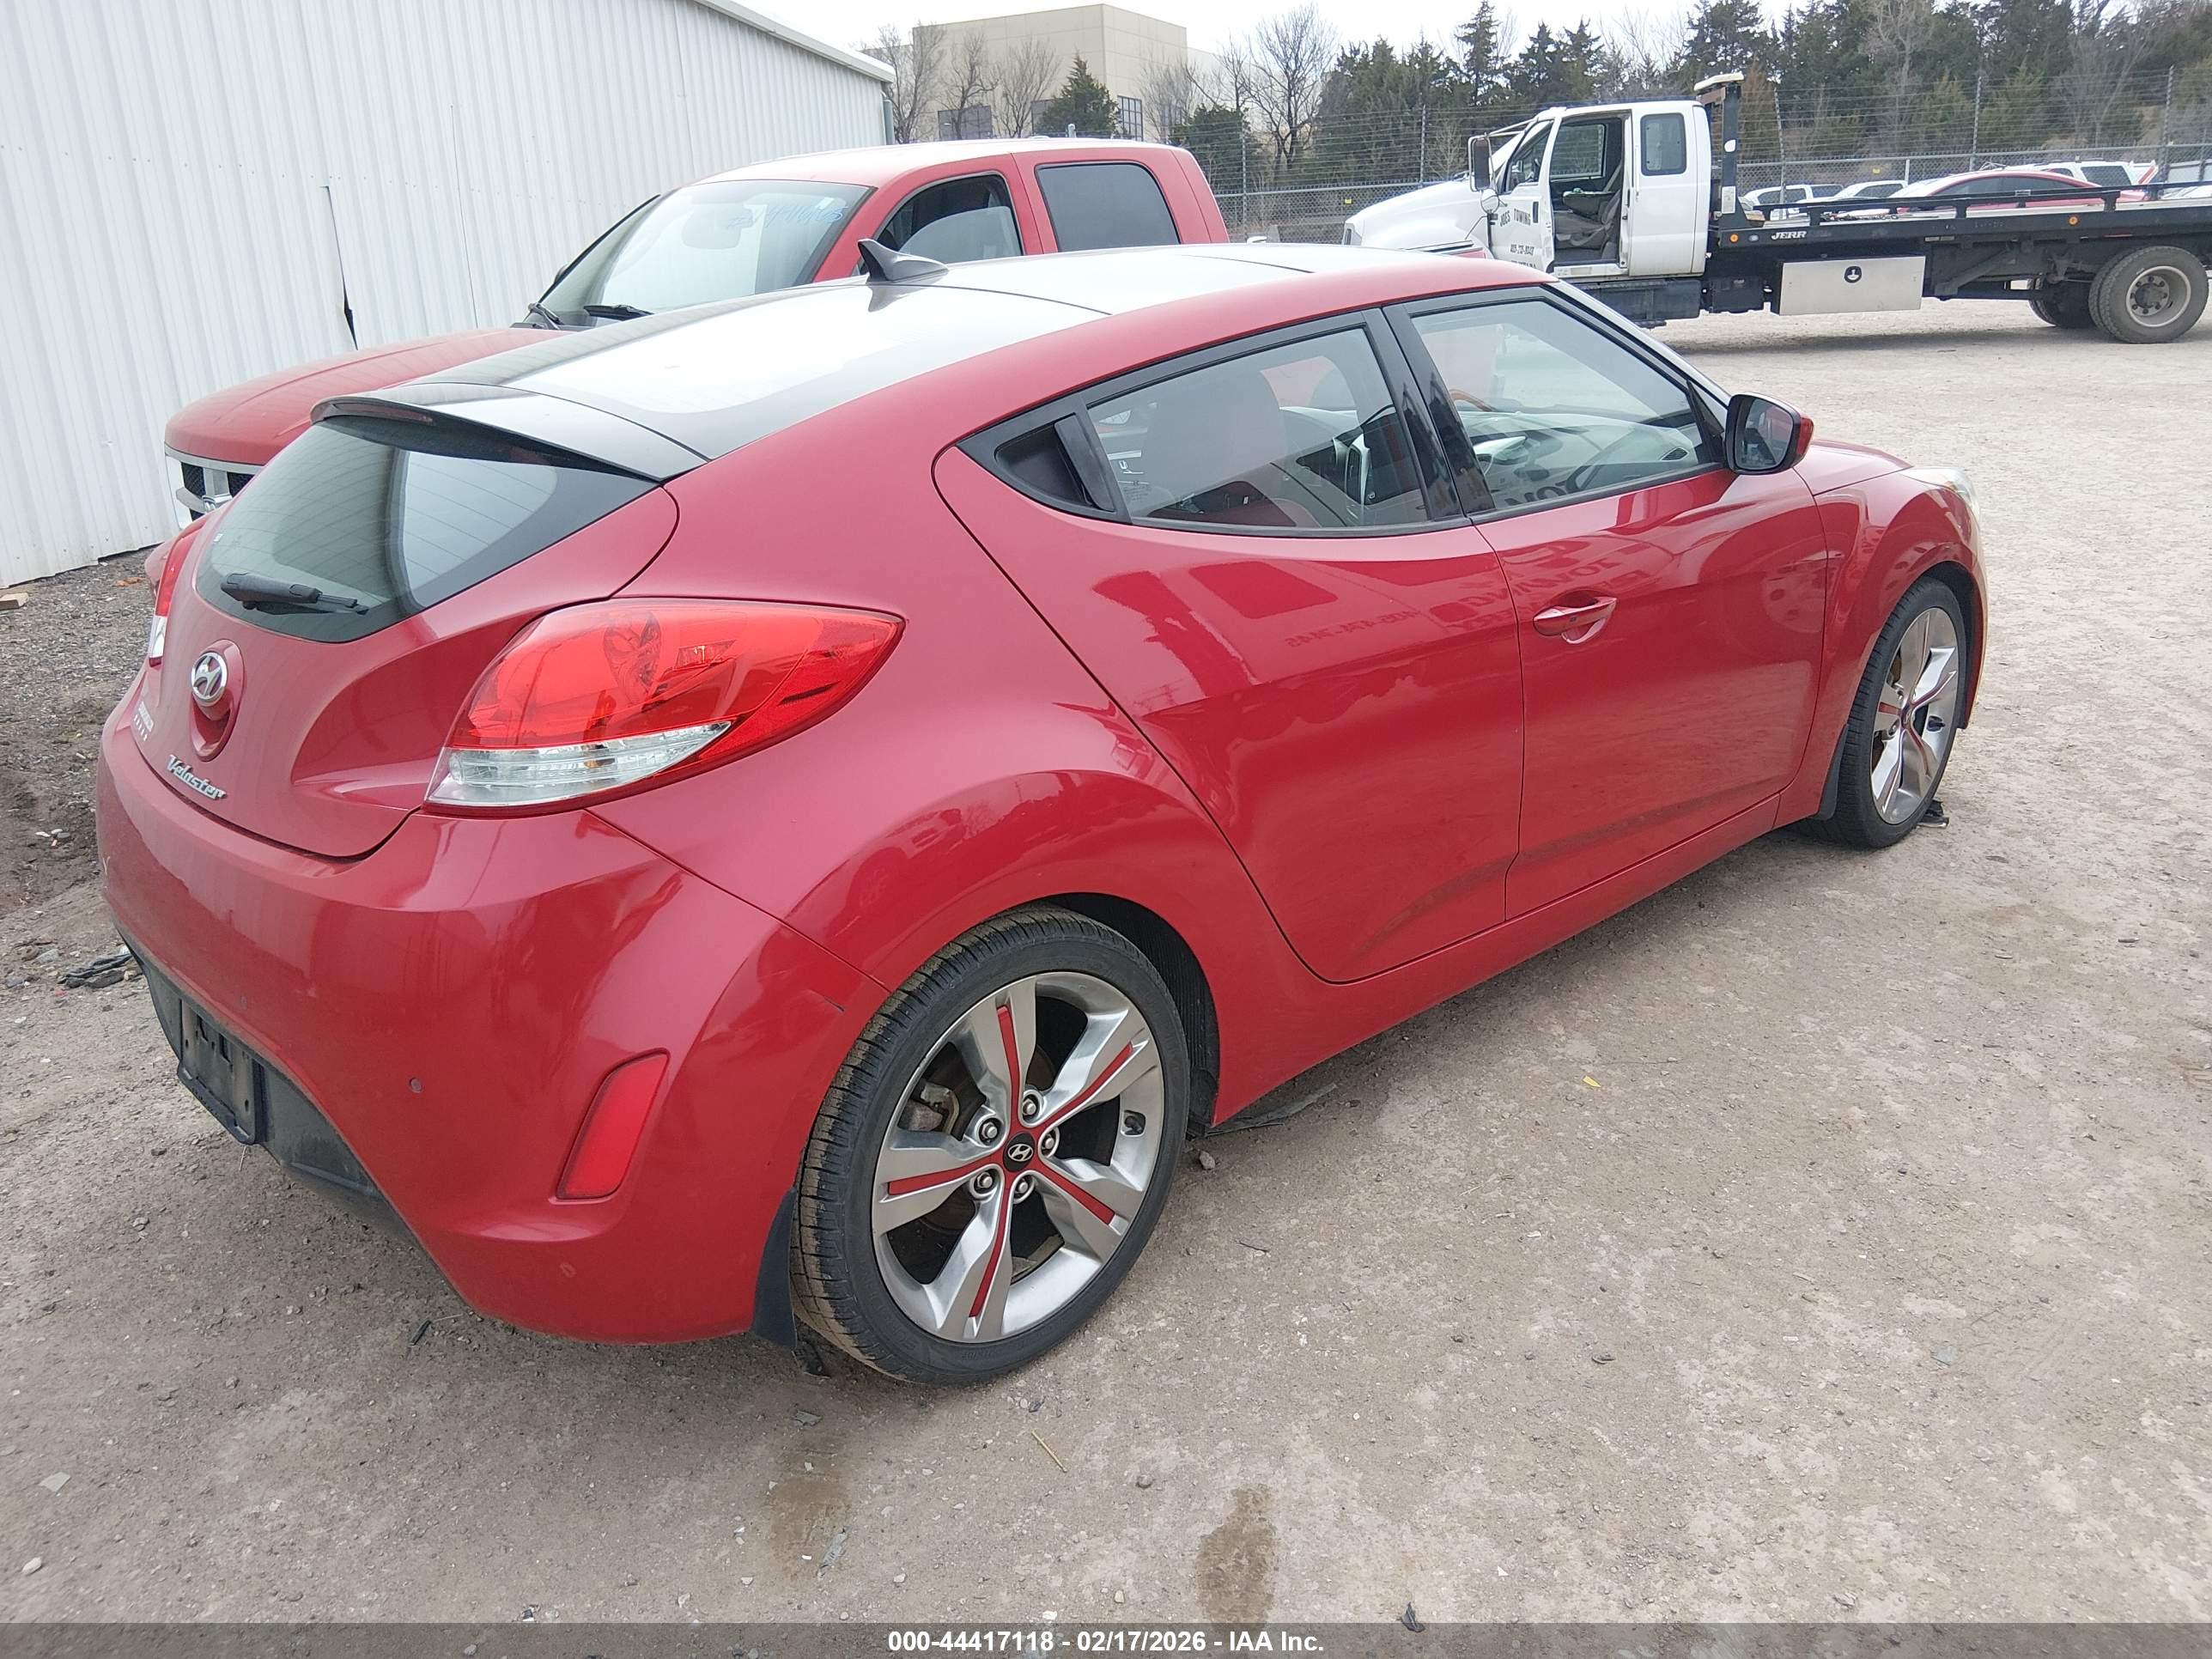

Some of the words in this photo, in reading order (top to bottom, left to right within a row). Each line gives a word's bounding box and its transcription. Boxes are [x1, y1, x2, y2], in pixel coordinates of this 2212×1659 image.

[1514, 209, 1530, 226] TOWING
[1771, 230, 1808, 240] JERR
[167, 754, 227, 799] Veloster
